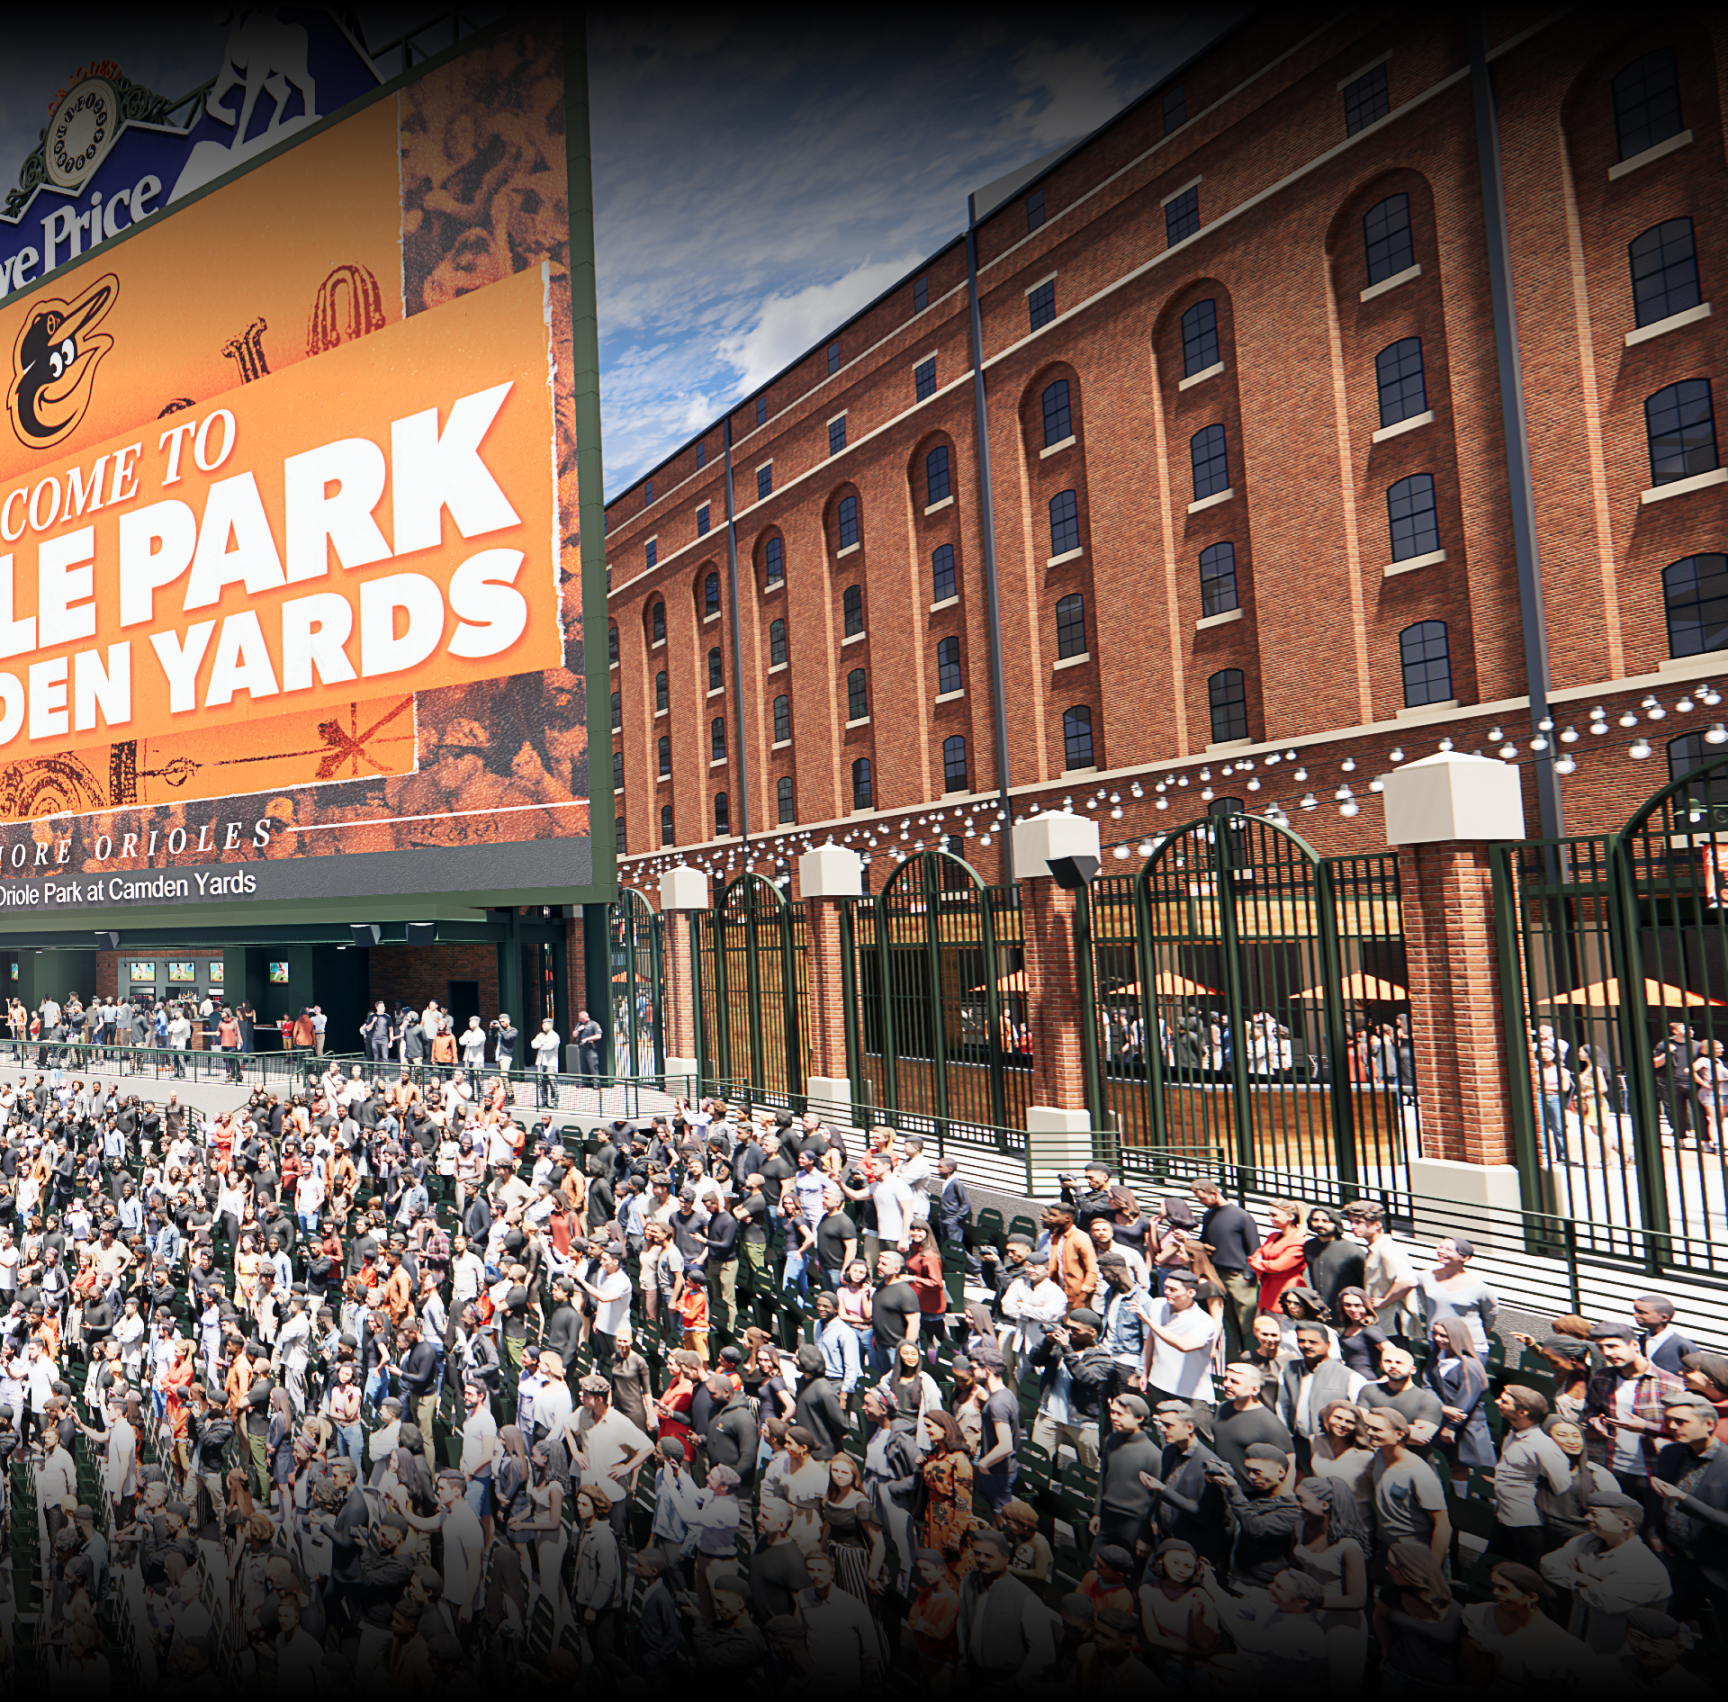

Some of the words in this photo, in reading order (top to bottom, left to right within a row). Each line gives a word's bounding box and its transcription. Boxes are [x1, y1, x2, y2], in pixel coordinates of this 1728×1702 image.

[158, 408, 237, 487] TO
[118, 380, 523, 628] PARK
[148, 547, 528, 714] YARDS
[95, 818, 272, 862] ORIOLES
[44, 882, 83, 904] Park
[87, 880, 105, 902] at
[107, 874, 189, 900] Camden
[193, 869, 257, 895] Yards
